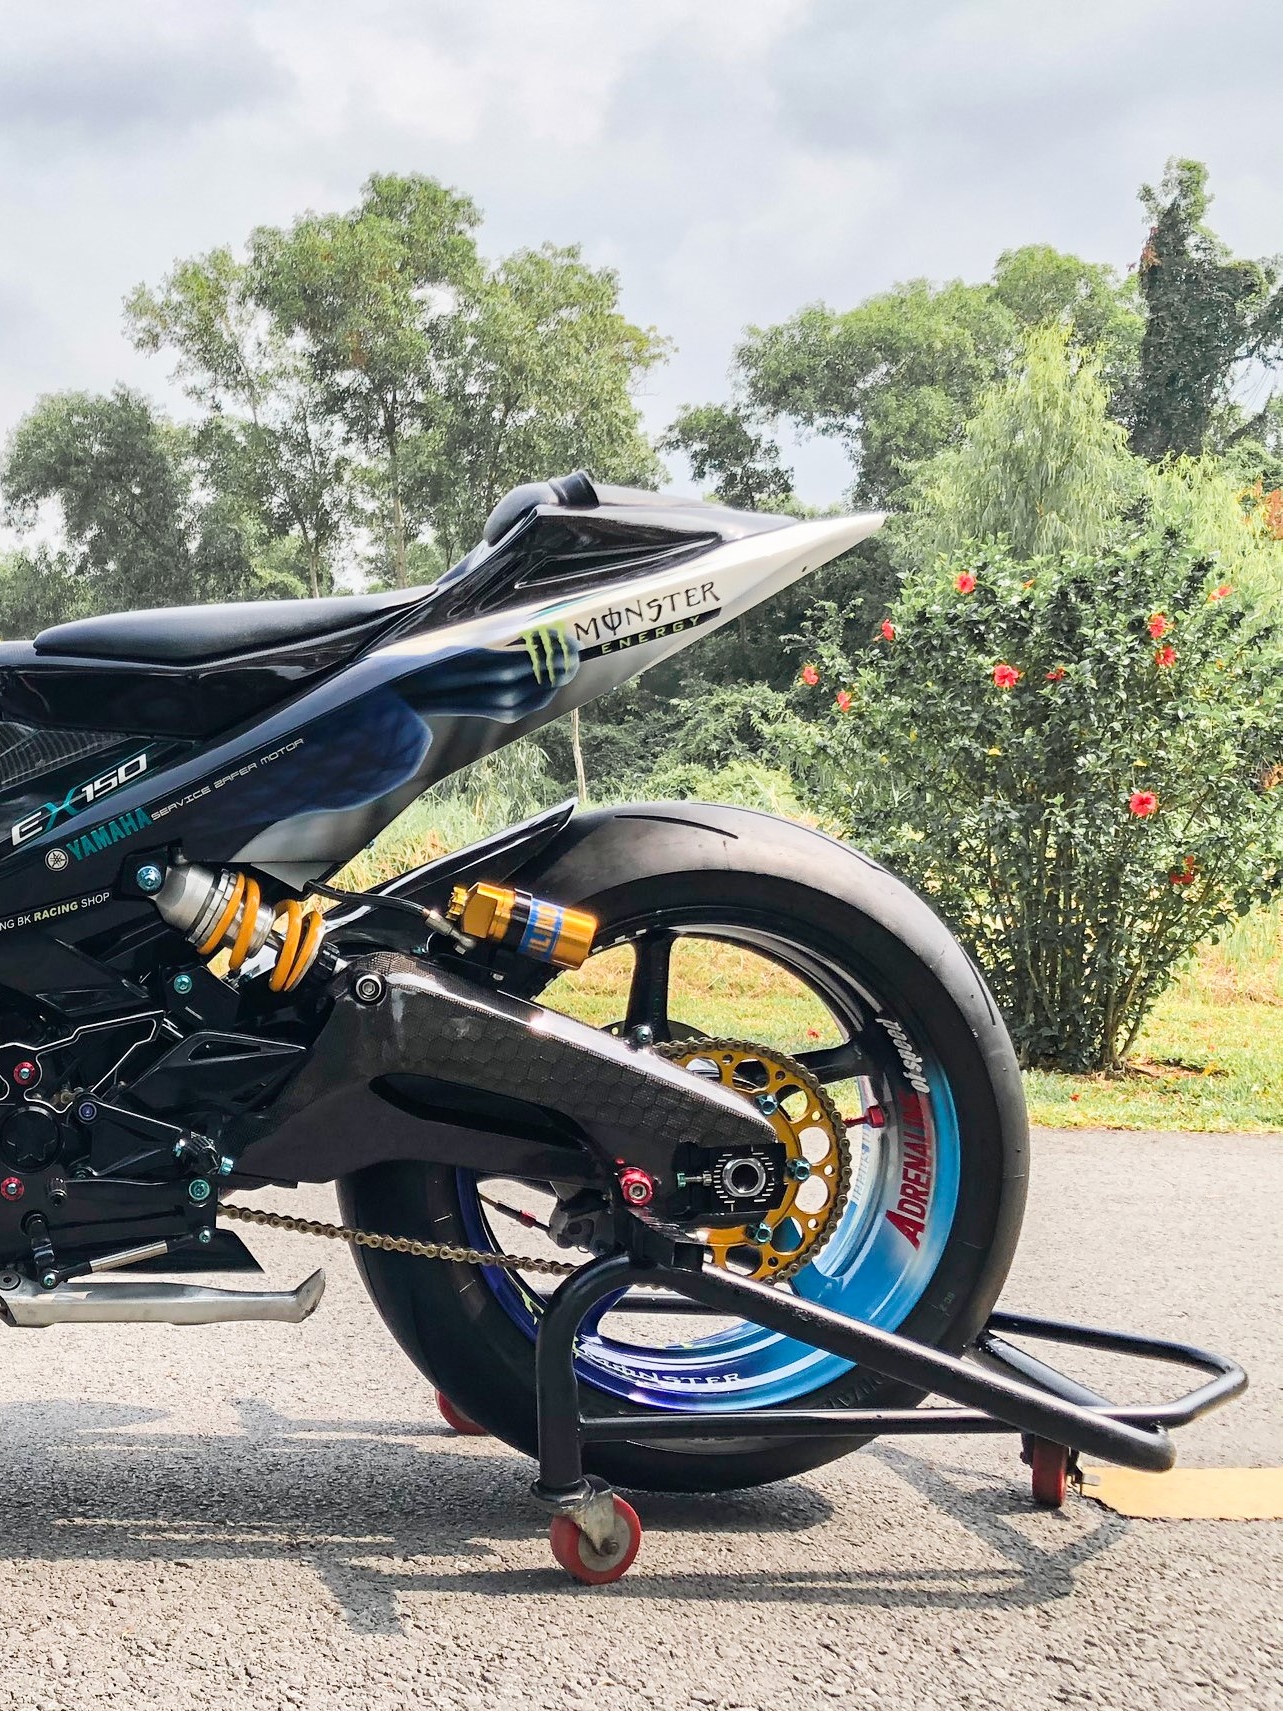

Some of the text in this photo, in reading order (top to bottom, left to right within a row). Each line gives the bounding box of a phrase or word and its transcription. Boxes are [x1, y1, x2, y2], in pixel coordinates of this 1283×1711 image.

[573, 581, 721, 641] MONSTER
[601, 615, 701, 654] ENERGY
[11, 753, 148, 846] EX150
[66, 807, 153, 861] YAMAHA
[151, 785, 211, 820] SERVICE
[260, 738, 304, 765] MOTOR
[17, 914, 32, 926] BK
[33, 901, 78, 921] RACING
[80, 892, 110, 908] SHOP
[874, 1018, 923, 1072] speed
[903, 1071, 931, 1094] of
